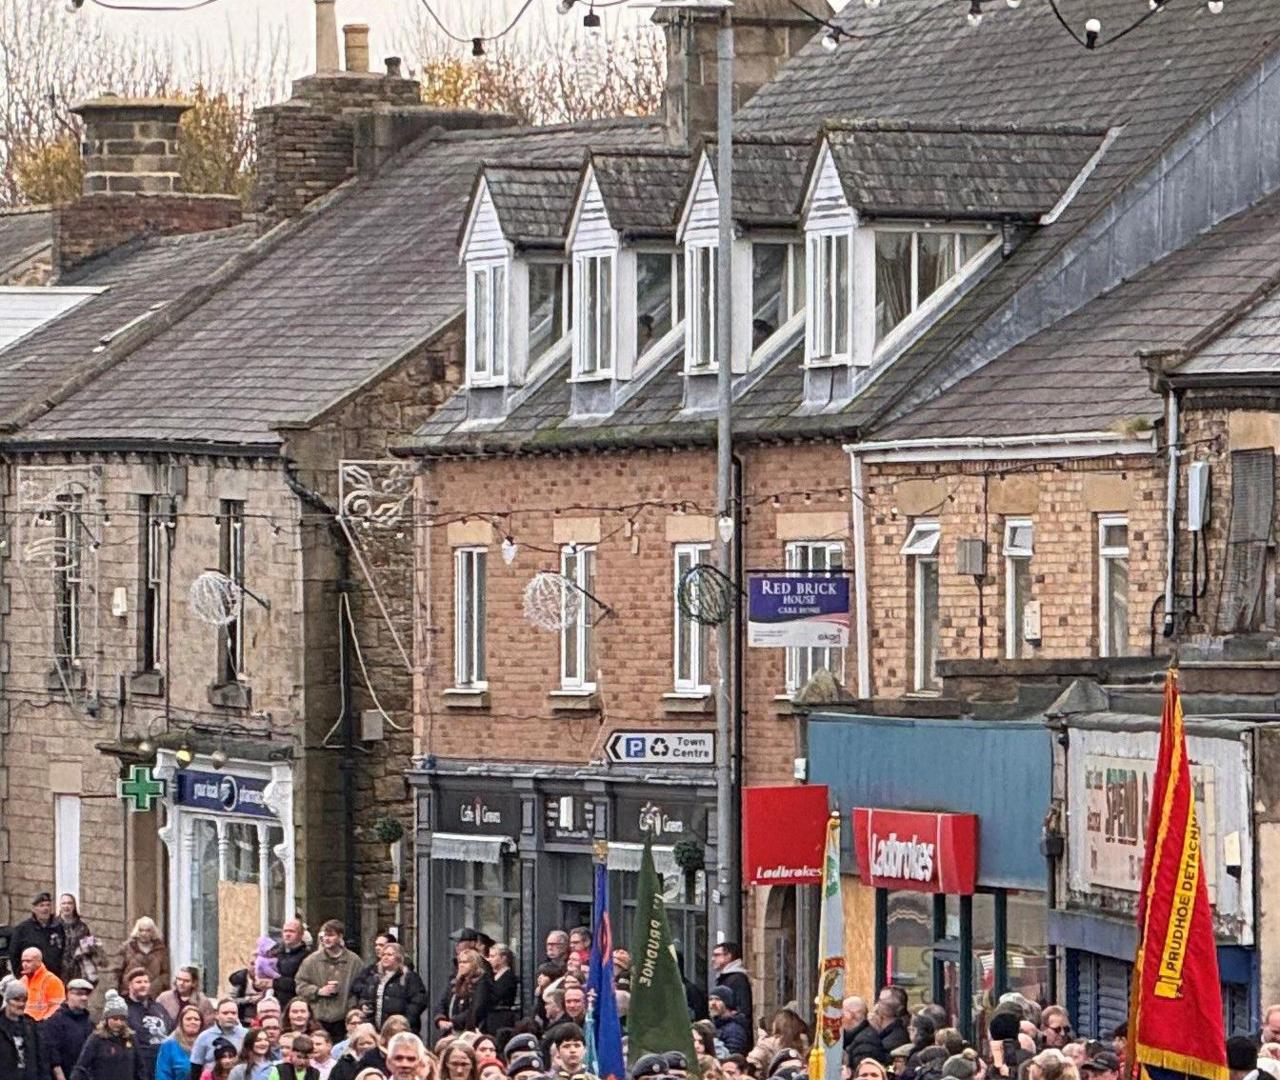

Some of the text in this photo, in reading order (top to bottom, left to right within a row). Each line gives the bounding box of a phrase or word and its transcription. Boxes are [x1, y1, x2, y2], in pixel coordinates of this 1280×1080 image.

[762, 580, 837, 595] RED BRICK
[783, 595, 816, 605] HOUSE
[677, 737, 705, 747] Town
[672, 748, 710, 758] Centre
[871, 832, 935, 883] Ladbrokes
[756, 865, 823, 879] Ladbrokes
[1166, 894, 1191, 972] PRUDHOE
